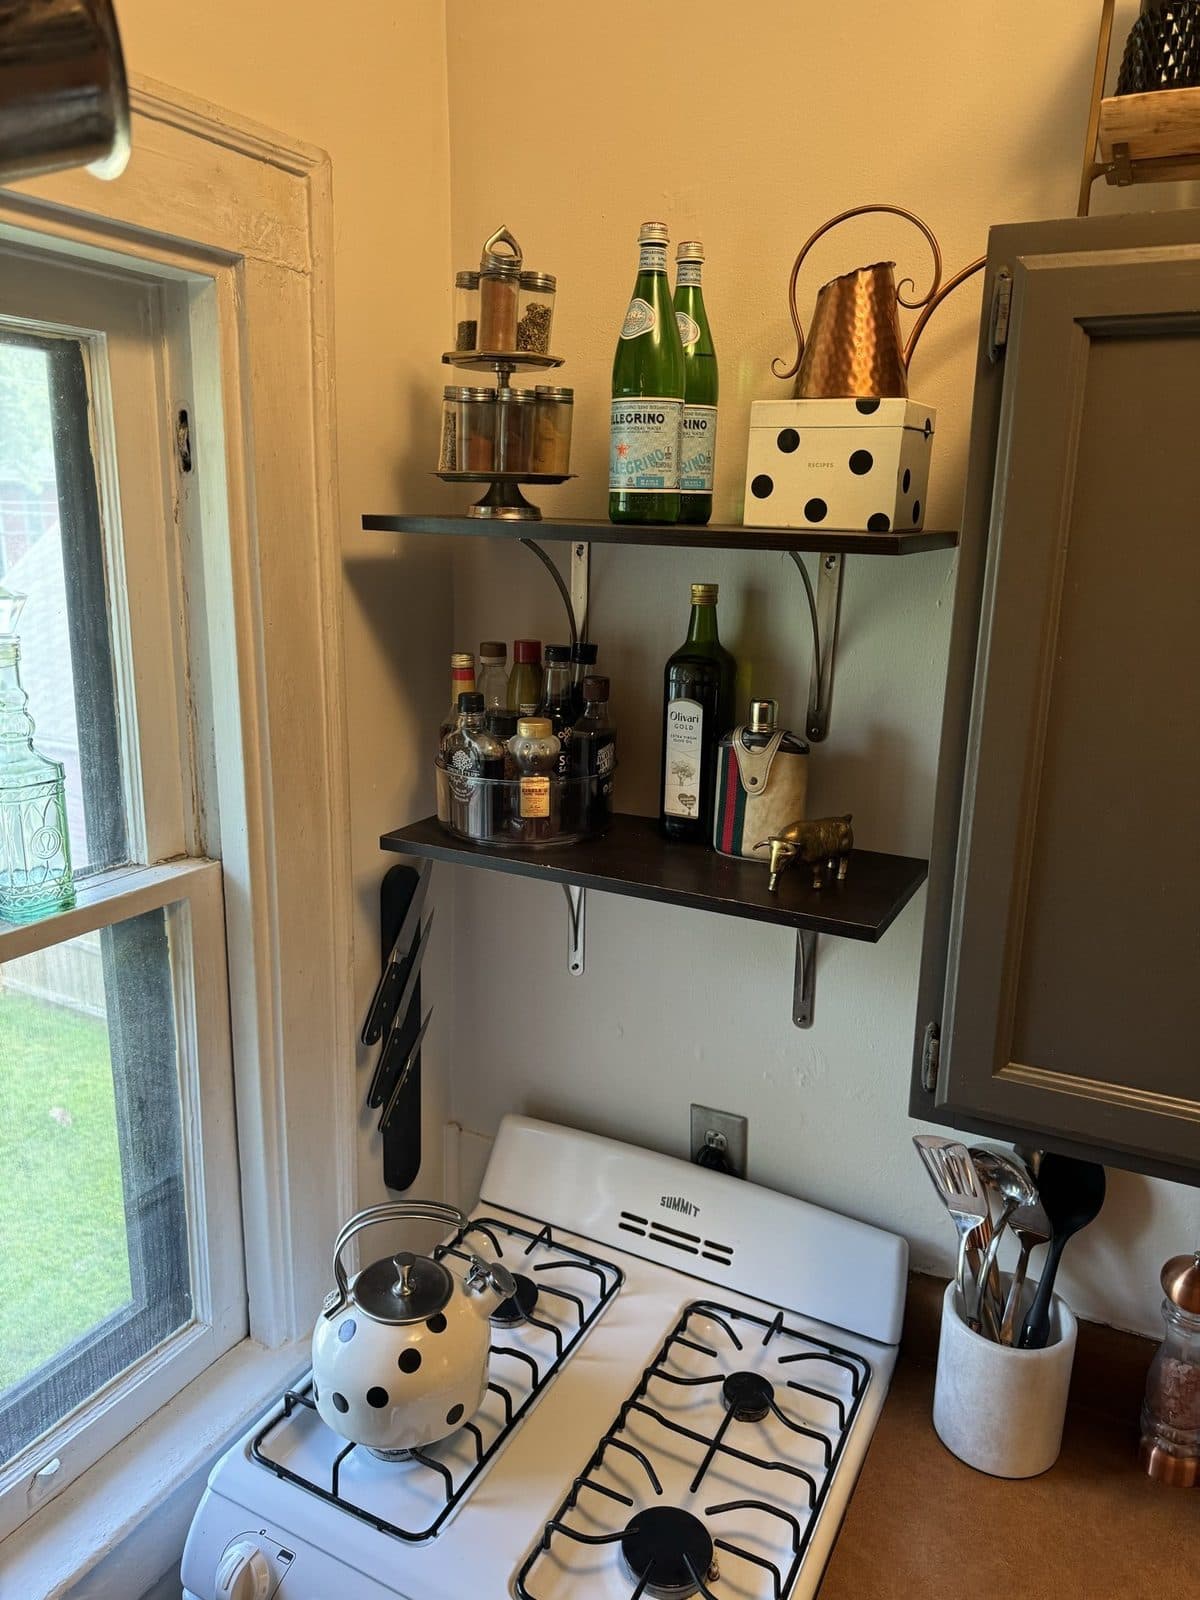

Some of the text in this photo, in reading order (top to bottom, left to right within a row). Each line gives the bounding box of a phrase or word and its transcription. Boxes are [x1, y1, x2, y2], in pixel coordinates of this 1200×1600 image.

[670, 711, 699, 724] Olivari
[674, 723, 694, 731] GOLD
[660, 1196, 700, 1218] SUMMIT
